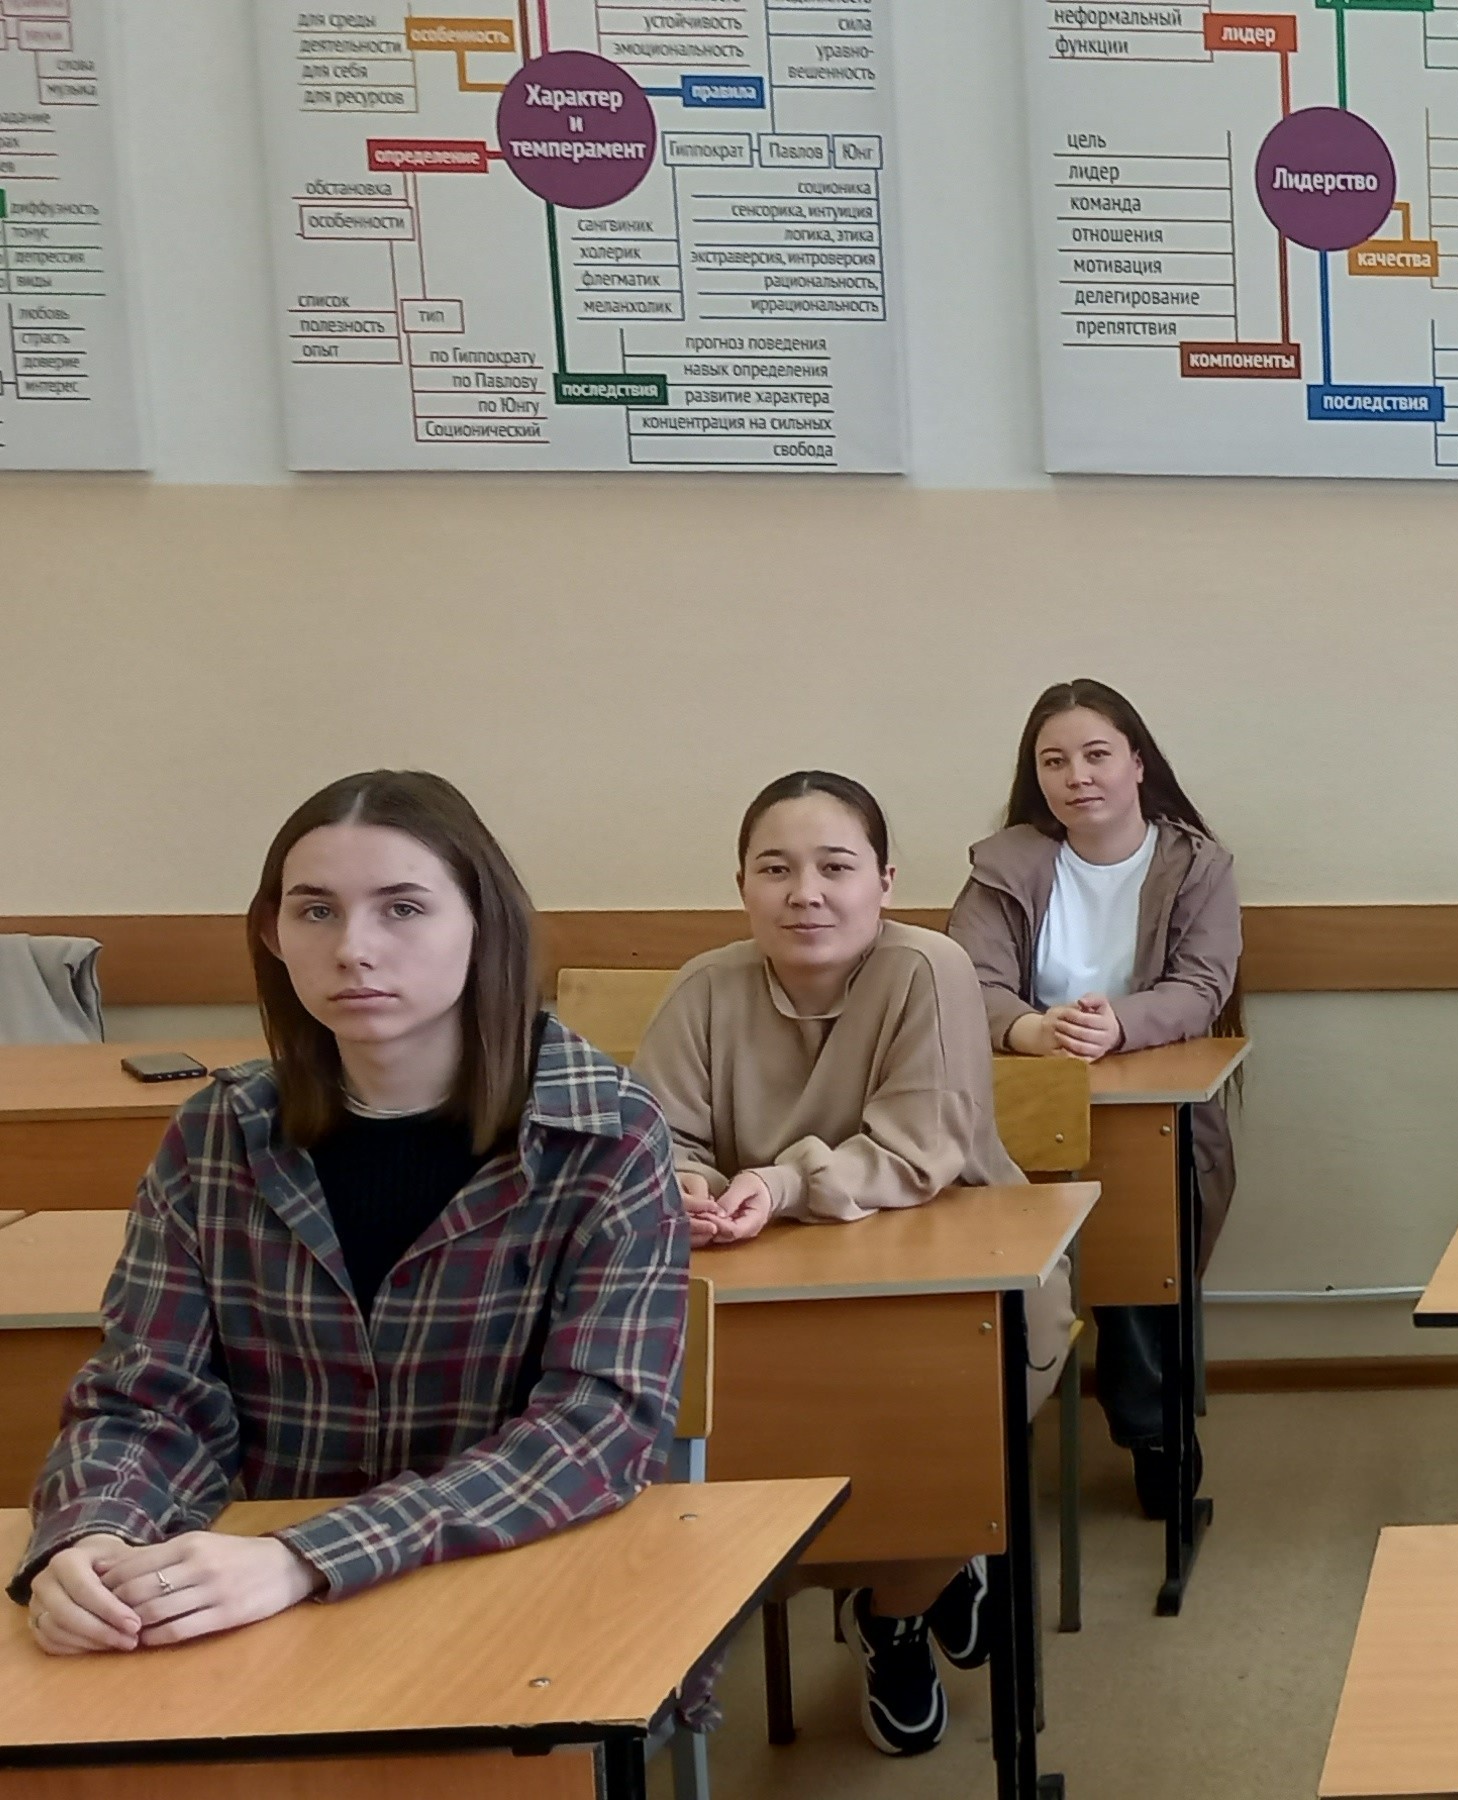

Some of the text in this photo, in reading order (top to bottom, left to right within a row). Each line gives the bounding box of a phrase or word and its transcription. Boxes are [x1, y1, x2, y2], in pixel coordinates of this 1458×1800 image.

[1054, 6, 1182, 28] неформальный
[410, 26, 510, 44] особенность
[1222, 26, 1276, 46] лидер
[1056, 36, 1128, 58] функции
[525, 83, 624, 112] Характер
[692, 84, 756, 102] правила
[568, 116, 584, 132] и
[670, 140, 744, 160] Гиппократ
[1067, 133, 1106, 150] цель
[374, 149, 480, 168] определение
[510, 139, 646, 164] темперамент
[769, 142, 824, 160] Павлов
[842, 143, 872, 160] Юнг
[1069, 166, 1120, 184] лидер
[1273, 166, 1378, 196] Лидерство
[798, 181, 871, 196] соционика
[1070, 197, 1142, 213] команда
[308, 212, 404, 228] особенности
[578, 219, 654, 233] сангвиник
[837, 230, 874, 242] этика
[1072, 228, 1163, 244] отношения
[580, 246, 641, 262] холерик
[1358, 252, 1432, 268] качества
[1074, 259, 1162, 276] мотивация
[582, 270, 660, 288] флегматик
[298, 296, 350, 308] список
[584, 300, 672, 314] меланхолик
[1074, 290, 1200, 308] делегирование
[419, 309, 444, 322] тип
[301, 320, 384, 334] полезность
[1076, 320, 1176, 338] препятствия
[686, 338, 826, 352] прогноз поведения
[430, 348, 536, 367] по Гиппократу
[1190, 352, 1296, 369] компоненты
[684, 364, 828, 378] навык определения
[452, 372, 538, 392] по Павлову
[562, 384, 658, 398] последствия
[686, 390, 830, 406] развитие характера
[478, 397, 540, 416] по Юнгу
[1323, 394, 1429, 412] последствия
[426, 421, 541, 439] Соционический
[642, 417, 832, 432] концентрация на сильных
[773, 442, 833, 458] свобода
